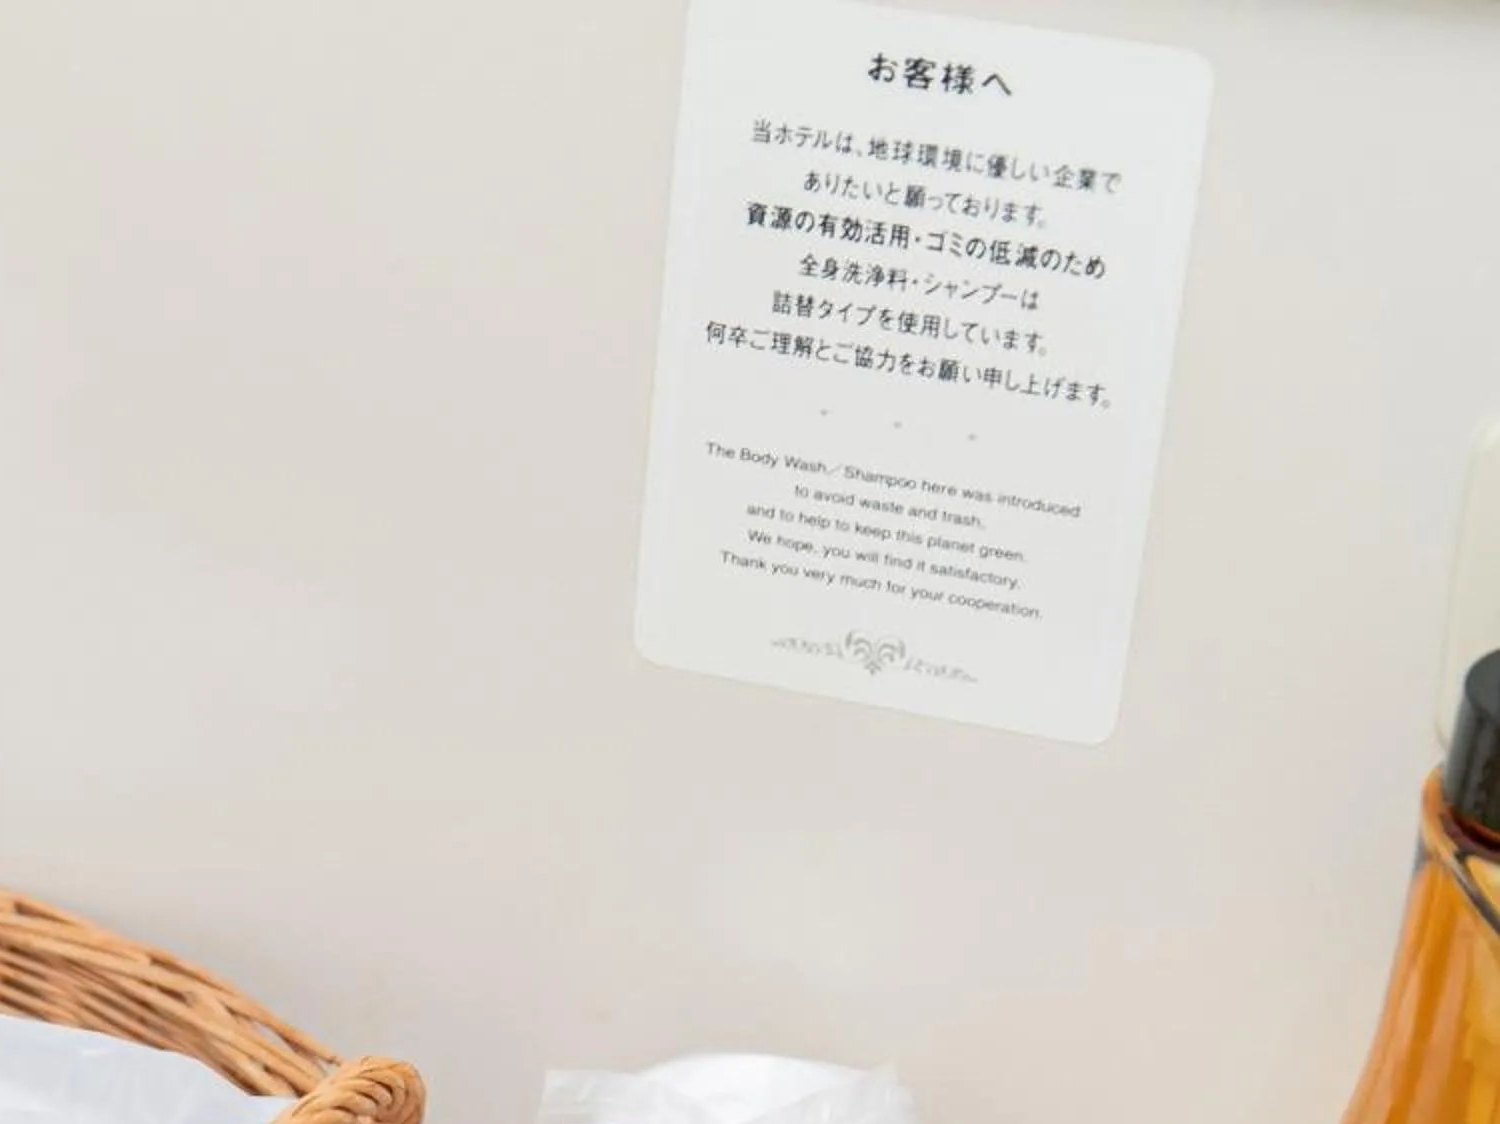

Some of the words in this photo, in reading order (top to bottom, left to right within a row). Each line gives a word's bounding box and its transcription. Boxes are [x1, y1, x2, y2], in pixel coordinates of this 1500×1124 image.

[867, 50, 1013, 97] お客様へ
[706, 441, 736, 460] The
[739, 447, 779, 468] Body
[921, 480, 957, 497] here
[961, 488, 993, 503] was
[997, 491, 1082, 518] introduced
[794, 484, 809, 499] to
[813, 489, 855, 507] avoid
[859, 497, 904, 515] waste
[907, 505, 938, 521] and
[746, 504, 776, 521] and
[779, 508, 794, 523] to
[798, 512, 831, 530] help
[835, 518, 851, 532] to
[854, 521, 891, 542] keep
[895, 529, 923, 545] this
[926, 535, 975, 555] planet
[748, 529, 772, 545] We
[822, 545, 851, 560] you
[855, 551, 879, 566] will
[883, 554, 913, 571] find
[721, 549, 766, 570] Thank
[770, 561, 799, 576] you
[802, 569, 835, 586] very
[839, 574, 882, 591] much
[886, 580, 907, 595] for
[910, 587, 943, 603] your
